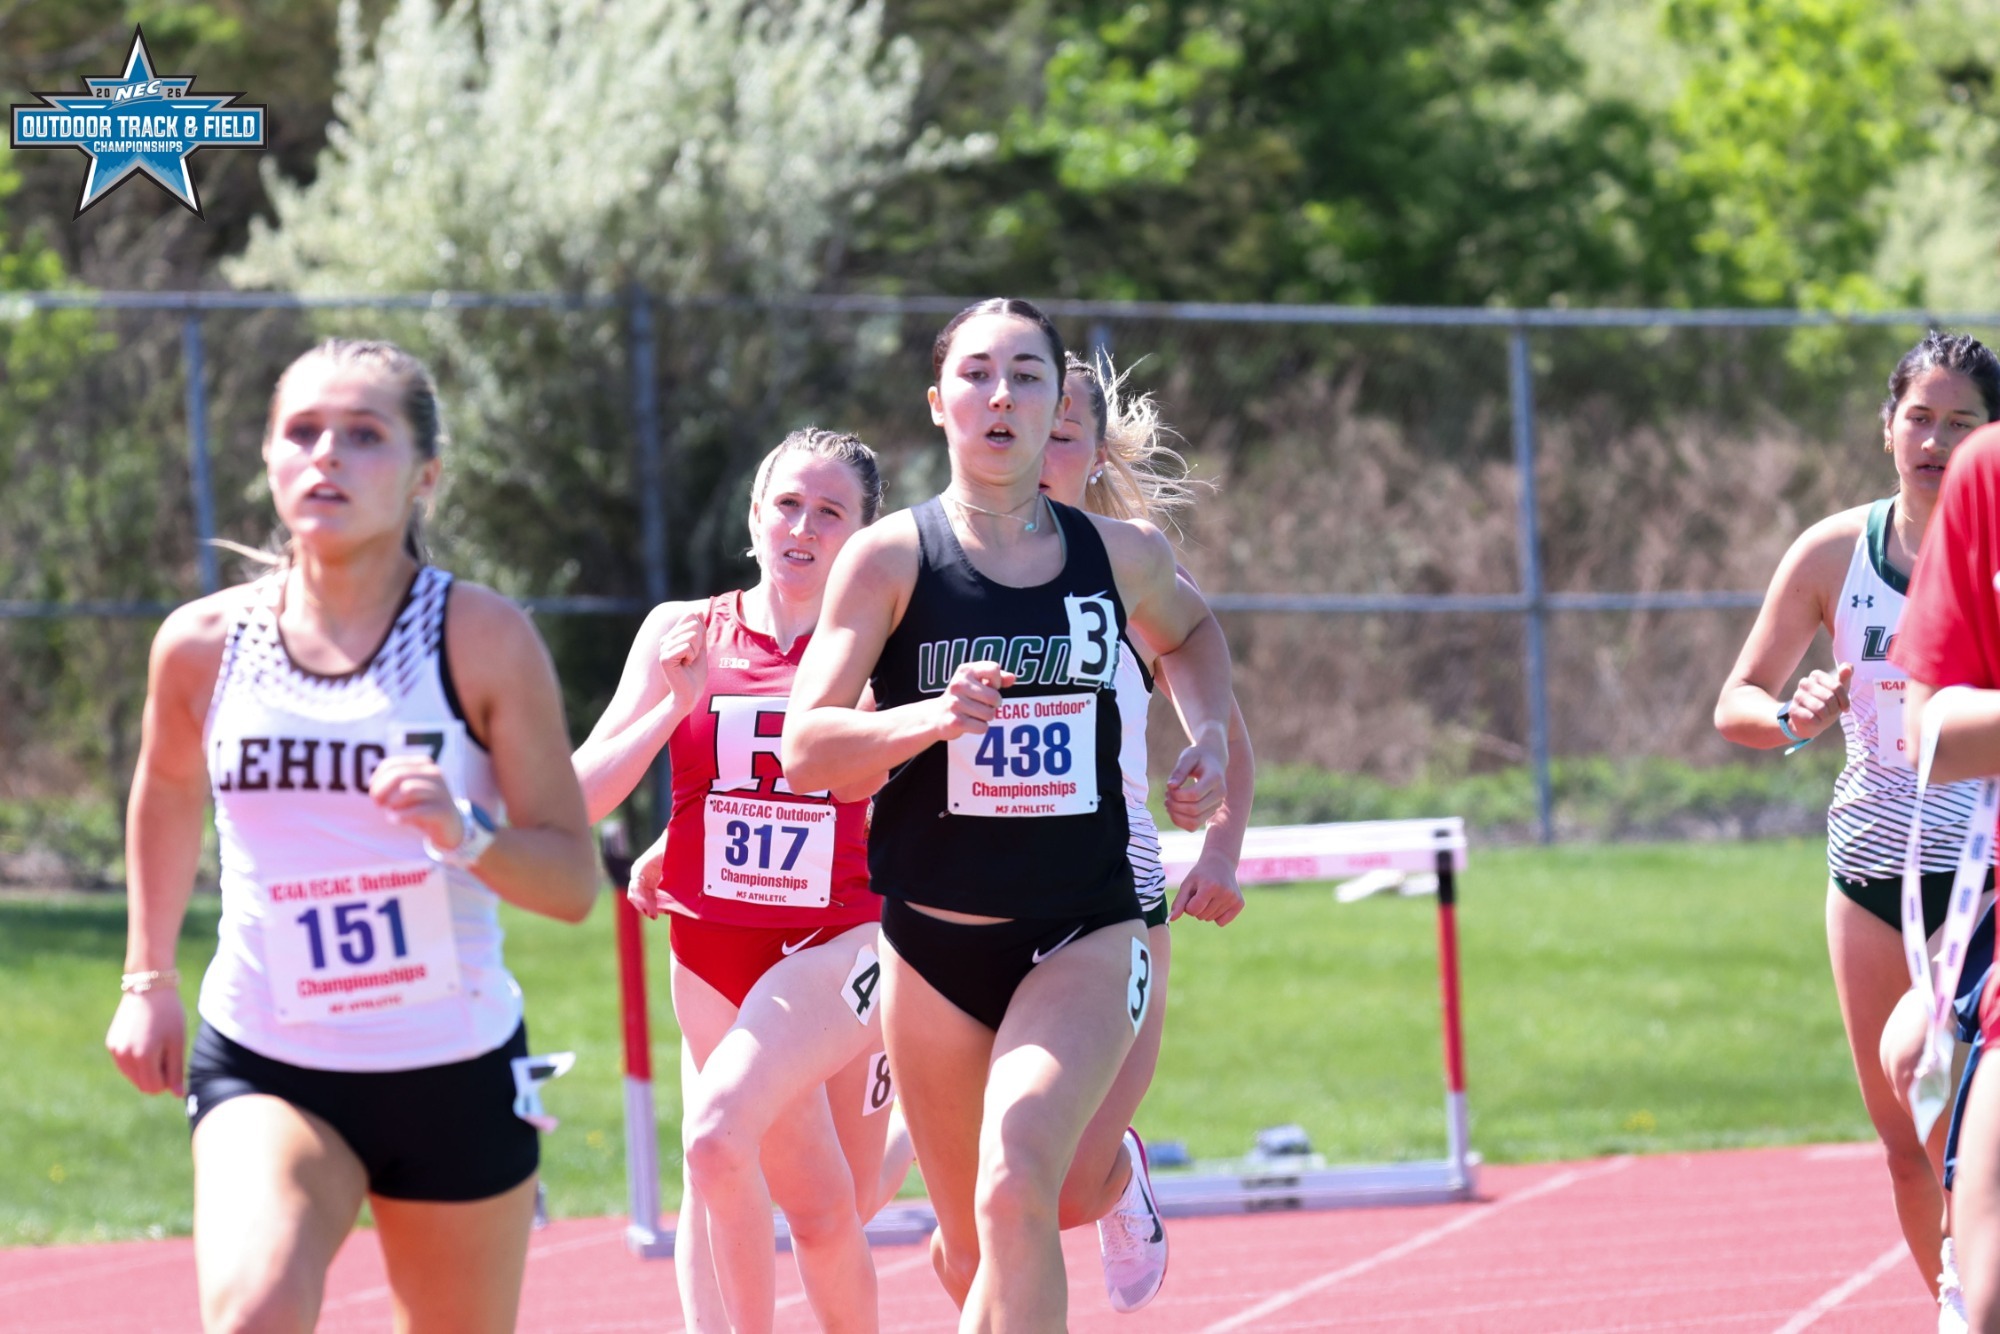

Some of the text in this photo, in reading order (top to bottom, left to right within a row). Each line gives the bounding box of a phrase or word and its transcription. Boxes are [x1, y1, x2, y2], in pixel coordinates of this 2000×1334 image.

[1079, 601, 1107, 676] 3
[1034, 701, 1085, 717] Outdoor
[217, 738, 388, 794] LEHIG
[974, 722, 1072, 777] 438
[776, 806, 825, 822] Outdoor
[972, 781, 1077, 799] Championships
[1011, 804, 1056, 814] ATHLETIC
[725, 820, 810, 871] 317
[721, 868, 808, 891] Championships
[748, 892, 787, 902] ATHLETIC
[297, 897, 407, 969] 151
[298, 964, 427, 996] Championships
[852, 961, 880, 1016] 4
[1131, 949, 1149, 1021] 3
[871, 1054, 891, 1108] 8
